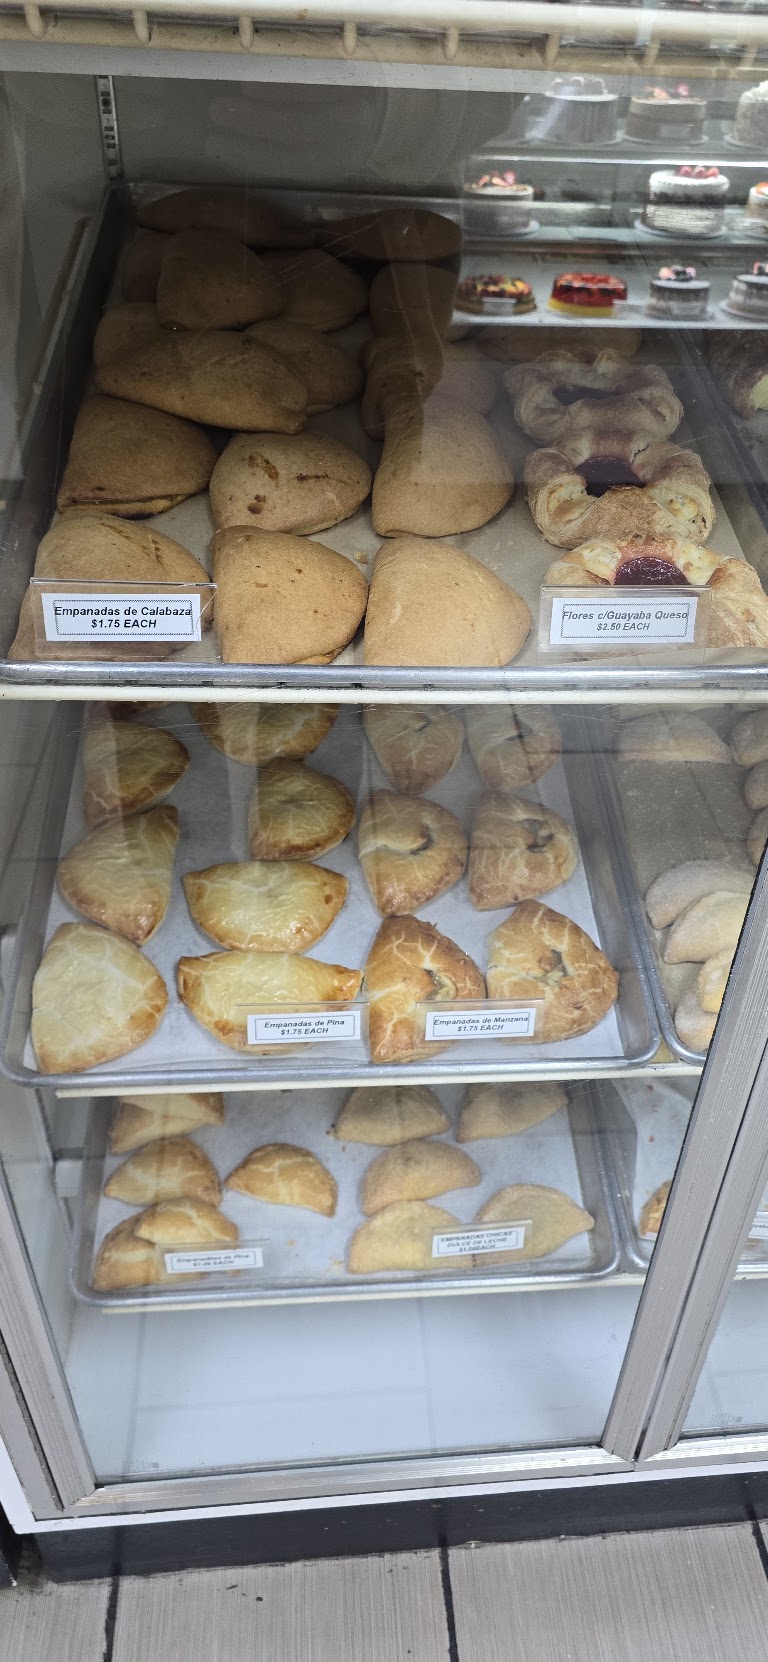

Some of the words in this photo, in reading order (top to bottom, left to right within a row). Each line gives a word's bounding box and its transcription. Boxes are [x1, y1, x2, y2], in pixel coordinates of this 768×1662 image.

[55, 606, 120, 617] Empanadas
[124, 606, 138, 616] de
[141, 606, 192, 616] Calabaza
[562, 610, 594, 620] Flores
[597, 610, 651, 621] c/Guayaba
[655, 610, 689, 620] Queso
[91, 619, 120, 629] $1.75
[123, 619, 157, 628] EACH
[596, 622, 621, 631] $2.50
[623, 622, 651, 631] EACH
[264, 1021, 312, 1029] Empanadas
[434, 1018, 480, 1026] Empanadas
